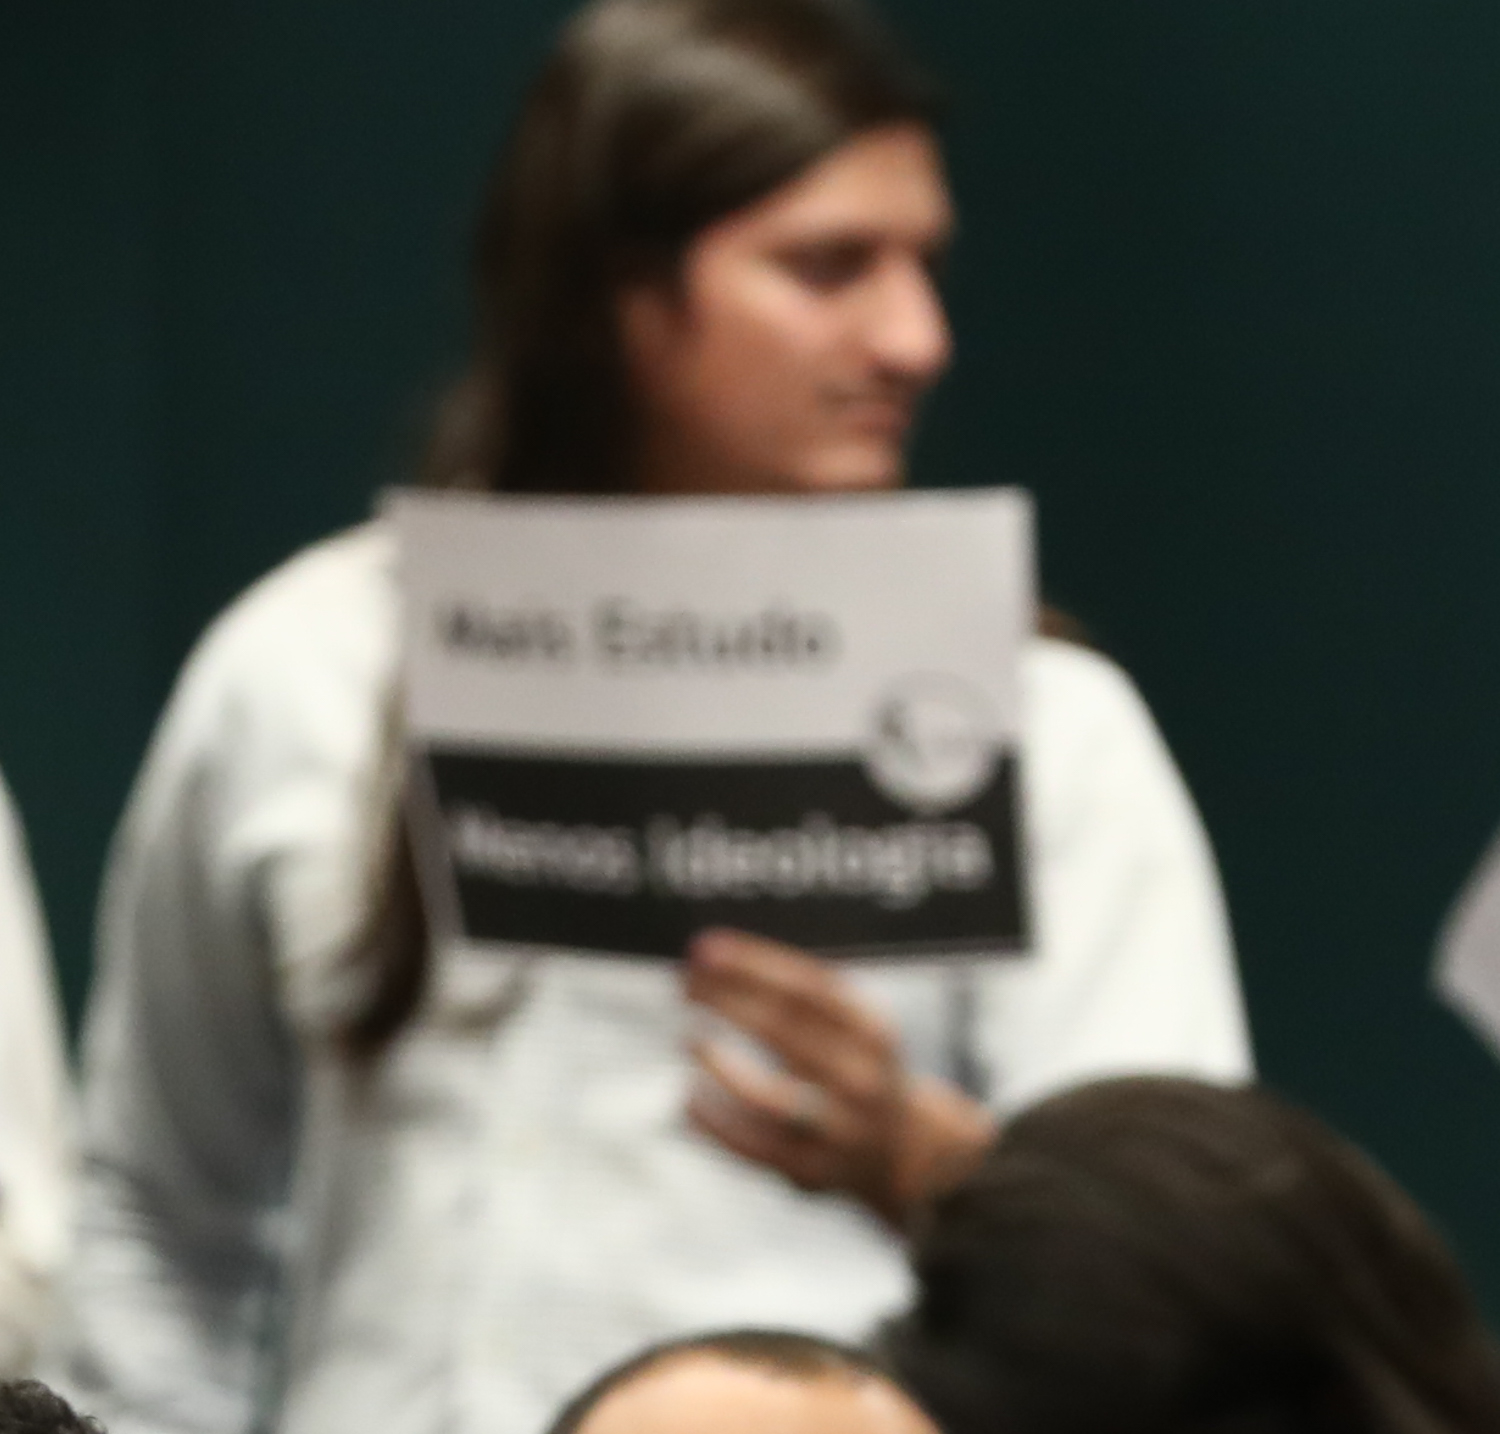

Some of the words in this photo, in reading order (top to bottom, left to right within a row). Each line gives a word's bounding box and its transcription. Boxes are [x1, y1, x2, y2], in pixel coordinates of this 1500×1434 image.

[436, 598, 574, 662] Mais
[590, 600, 835, 668] Estudo
[450, 810, 638, 889] Menos
[652, 813, 989, 903] Ideologia
